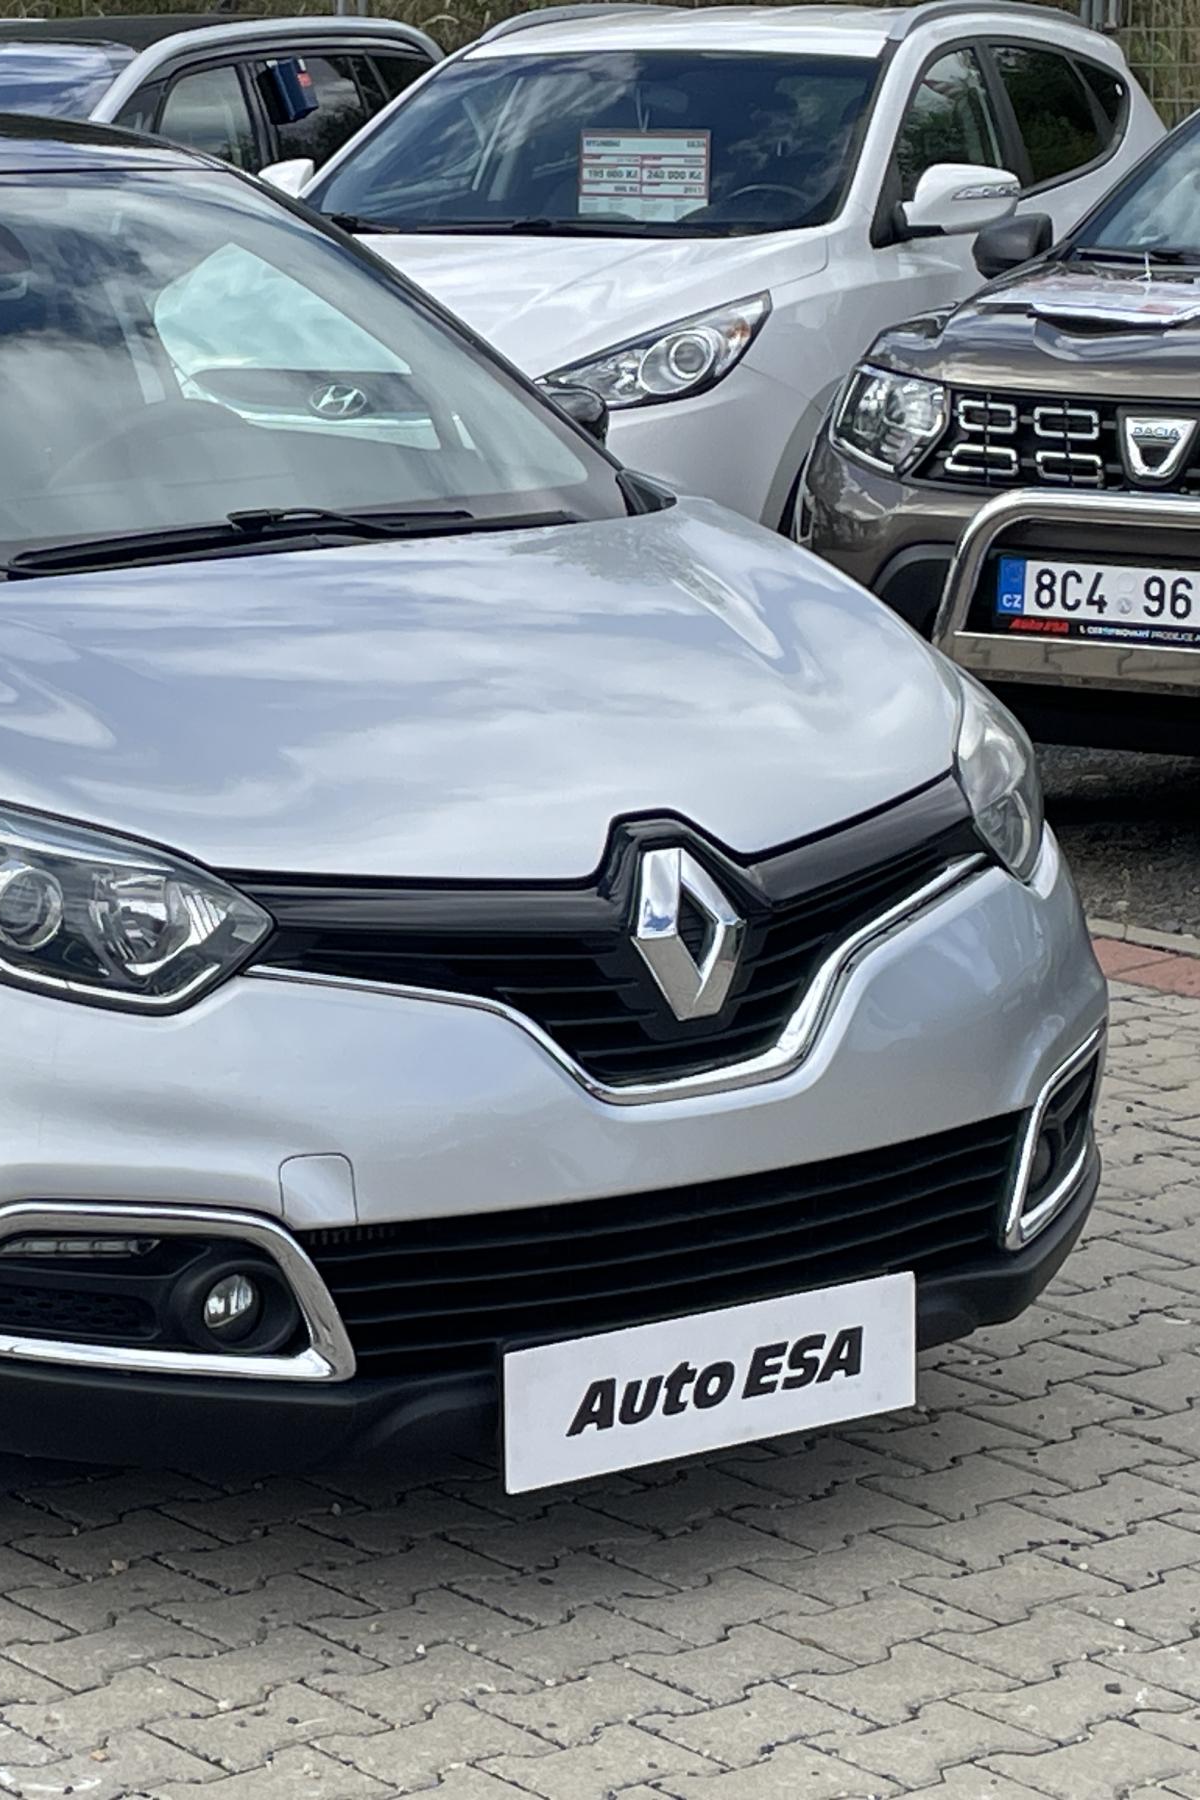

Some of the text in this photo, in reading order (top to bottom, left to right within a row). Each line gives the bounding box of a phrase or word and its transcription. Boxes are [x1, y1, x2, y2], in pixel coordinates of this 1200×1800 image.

[1133, 426, 1180, 439] DACIA
[1002, 568, 1194, 620] CZ 8C4 96
[565, 1325, 864, 1438] Auto ESA
